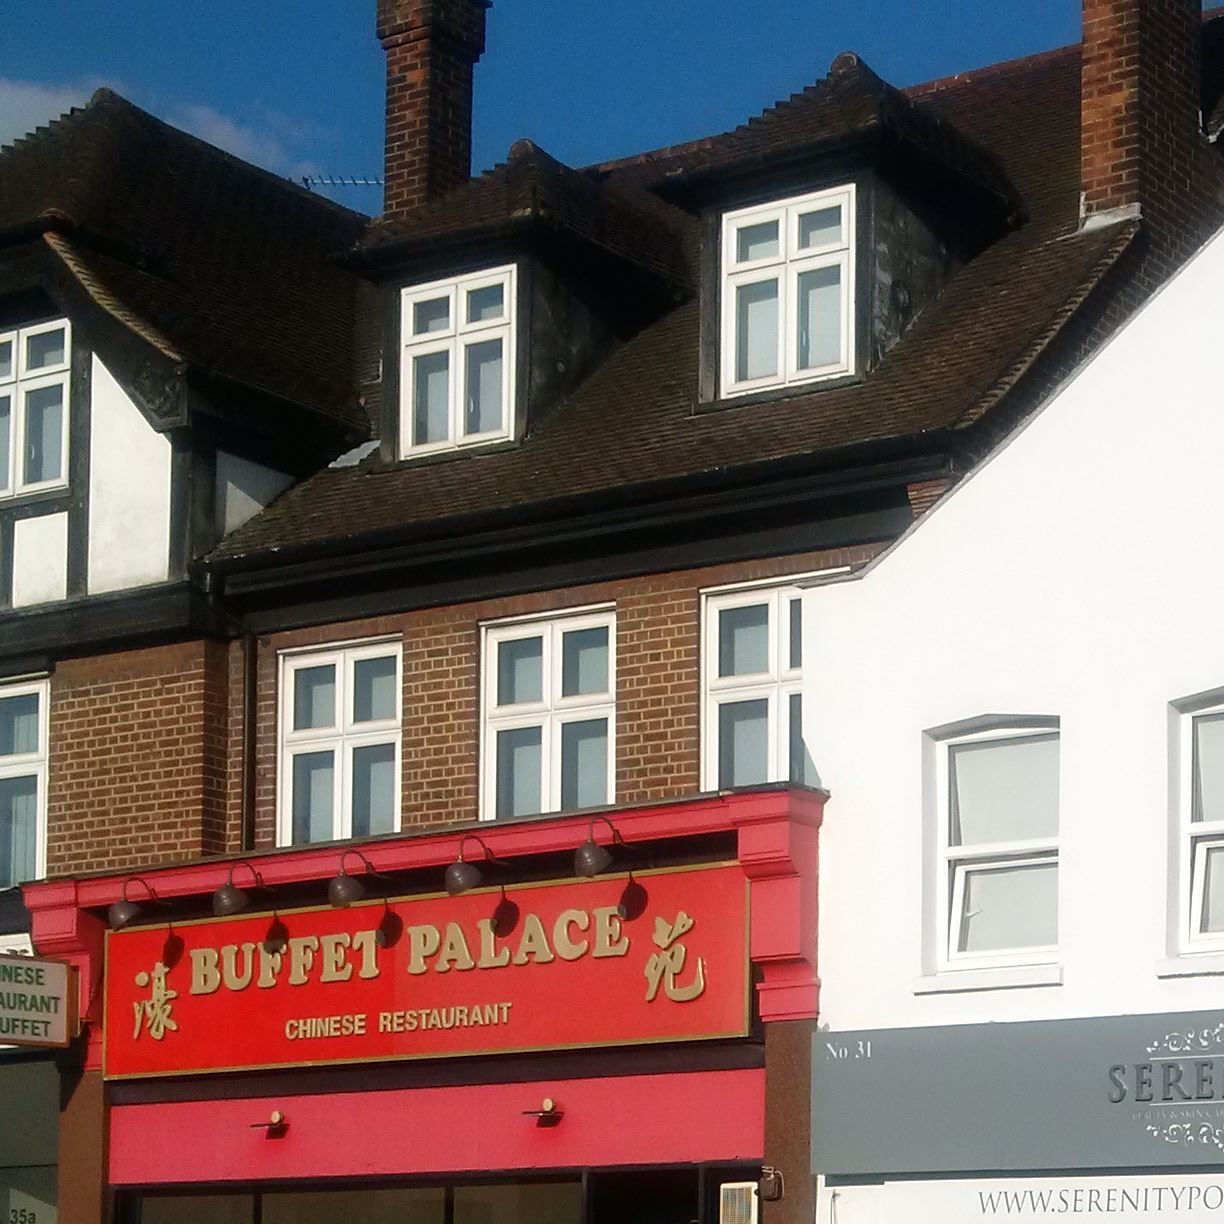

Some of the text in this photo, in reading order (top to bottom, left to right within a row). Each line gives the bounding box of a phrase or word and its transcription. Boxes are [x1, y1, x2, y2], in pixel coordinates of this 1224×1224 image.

[189, 906, 631, 995] BUFFET PALACE
[285, 1002, 512, 1039] CHINESE RESTAURANT
[826, 1040, 872, 1060] No 31
